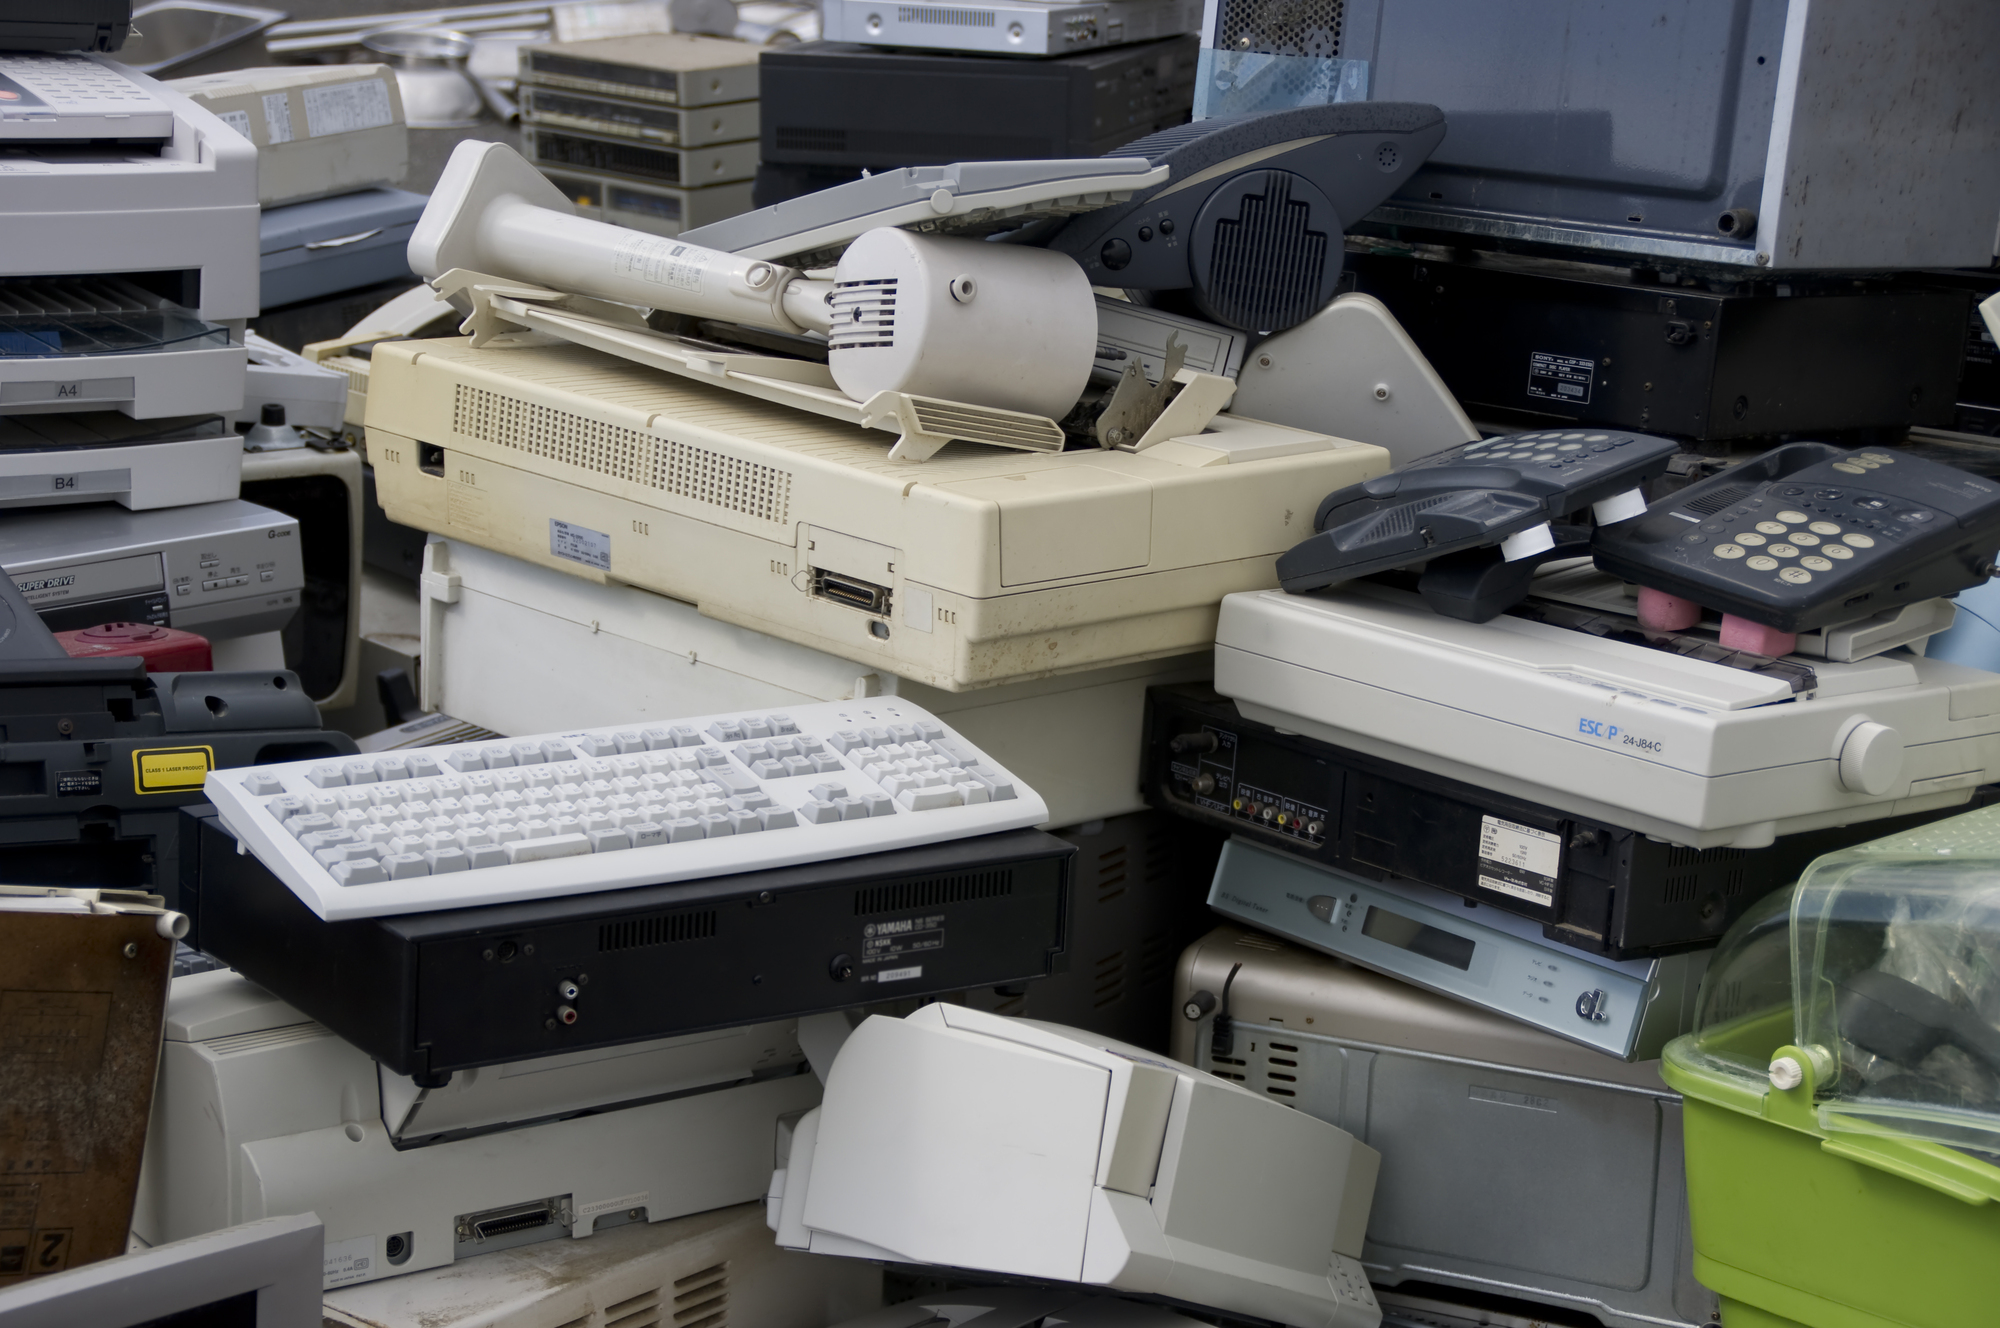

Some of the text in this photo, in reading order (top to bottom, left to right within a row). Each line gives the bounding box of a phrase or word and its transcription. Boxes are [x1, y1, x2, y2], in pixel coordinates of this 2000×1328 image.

[58, 385, 78, 398] A4
[55, 477, 75, 490] B4
[18, 575, 75, 592] SUPER DRIVE
[877, 919, 912, 935] YAMAHA
